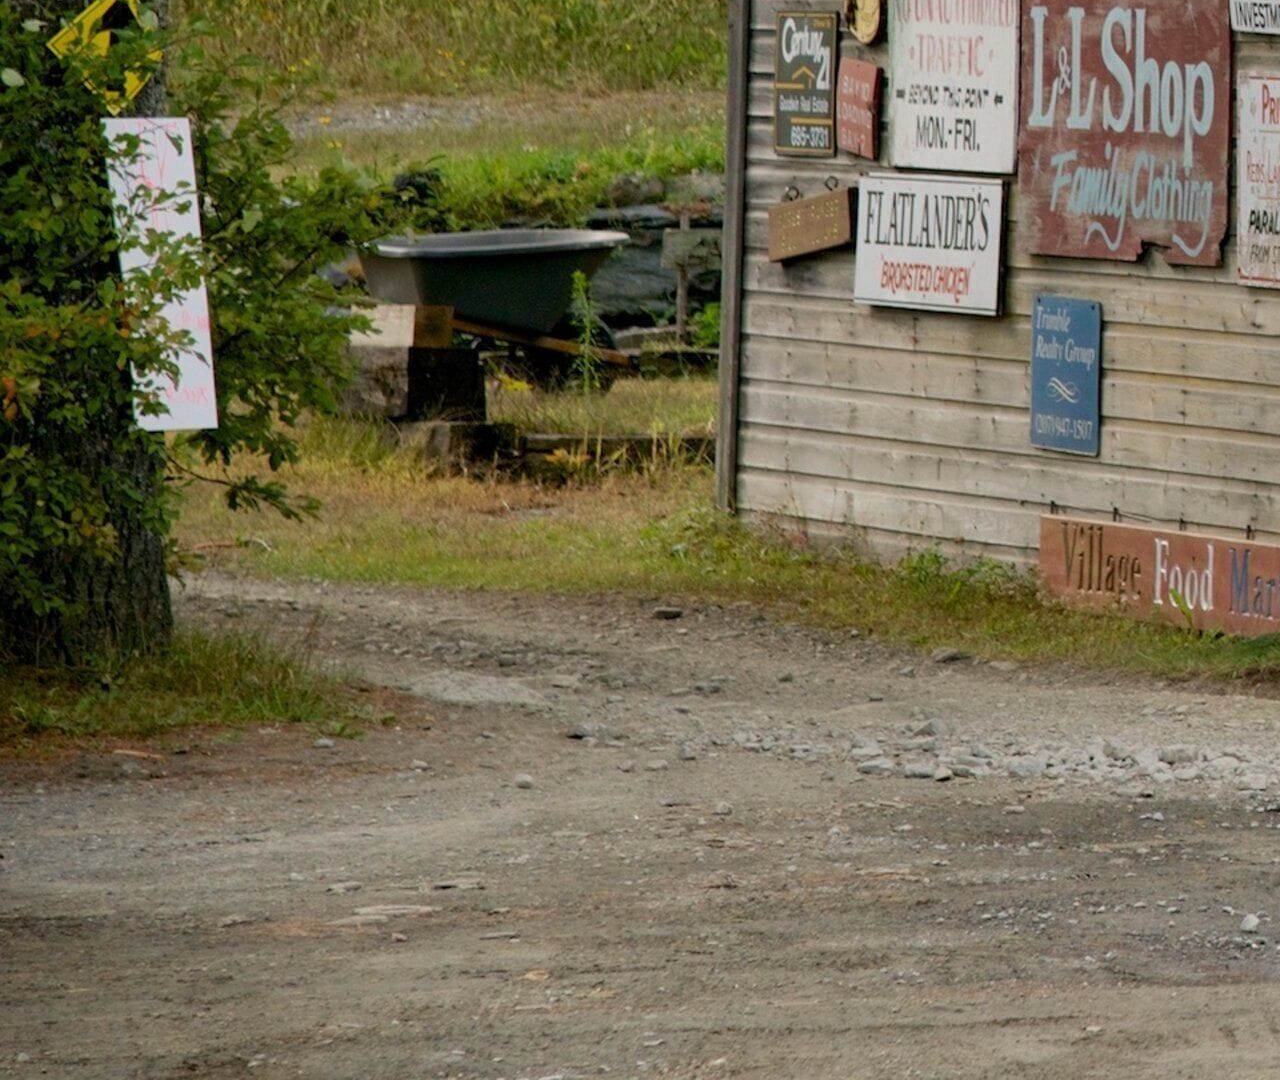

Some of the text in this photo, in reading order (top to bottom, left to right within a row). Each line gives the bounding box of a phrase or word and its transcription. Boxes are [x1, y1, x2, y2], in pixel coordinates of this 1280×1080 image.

[781, 17, 824, 64] Century
[1100, 6, 1216, 176] Shop
[864, 189, 991, 252] FLATLANDER'S
[1050, 143, 1213, 257] Family Clothing
[1060, 520, 1143, 602] Village
[1153, 536, 1216, 612] Food
